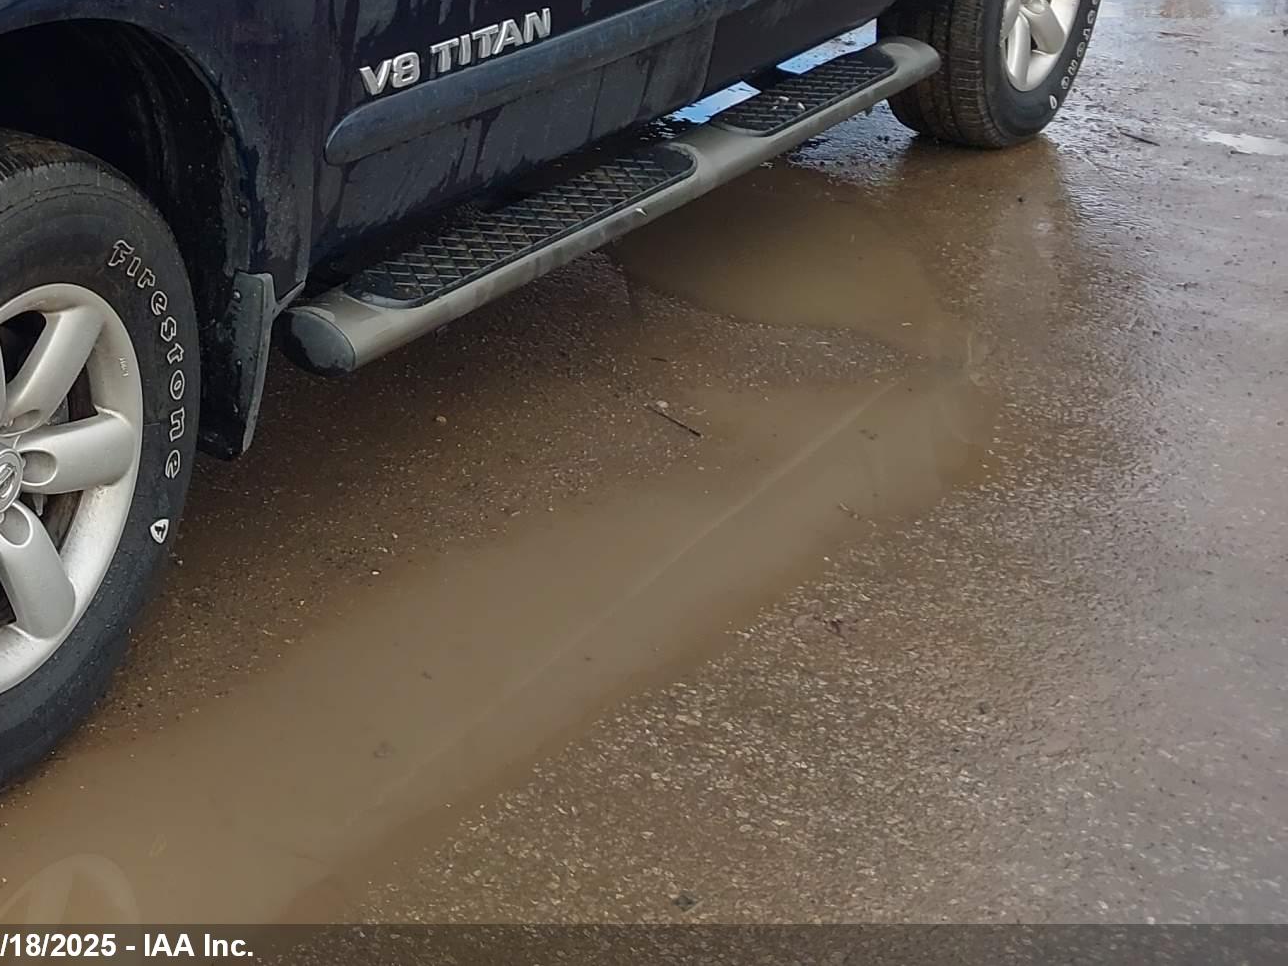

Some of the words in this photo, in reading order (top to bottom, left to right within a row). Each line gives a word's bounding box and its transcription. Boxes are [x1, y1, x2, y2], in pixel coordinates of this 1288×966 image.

[359, 51, 421, 96] V8
[429, 8, 552, 73] TITAN
[107, 239, 187, 479] Firestone
